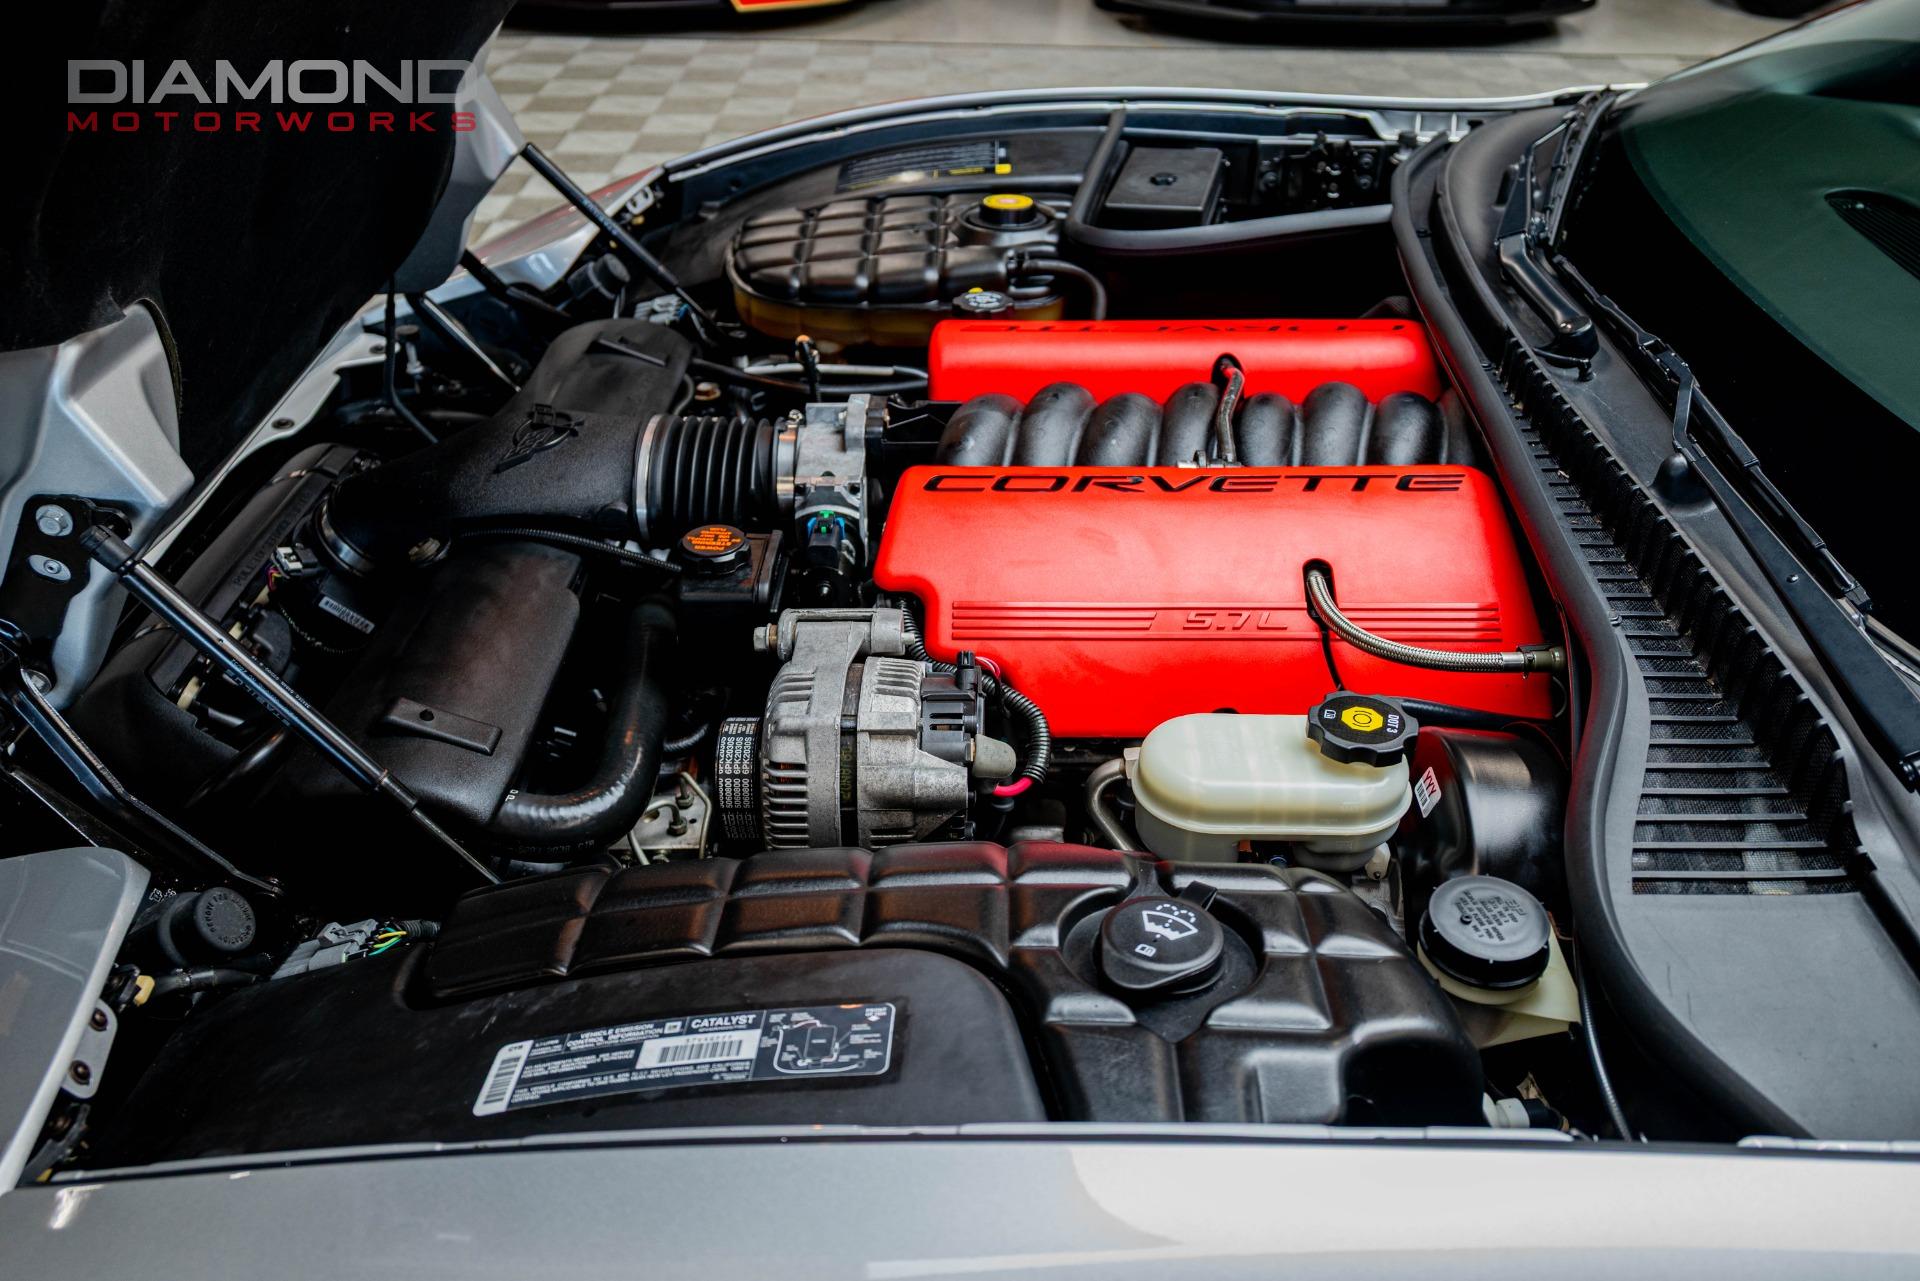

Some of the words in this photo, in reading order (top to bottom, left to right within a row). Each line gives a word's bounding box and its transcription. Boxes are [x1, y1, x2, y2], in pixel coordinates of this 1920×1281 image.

[922, 474, 1466, 493] CORVETTE
[1182, 610, 1289, 631] 5.7L
[1387, 714, 1400, 728] DOT
[724, 736, 735, 774] 6PK2030S
[733, 736, 744, 774] 6PK2030S
[741, 736, 752, 774] 6PK2030S
[1423, 770, 1437, 798] YYY
[691, 1014, 756, 1029] CATALYST
